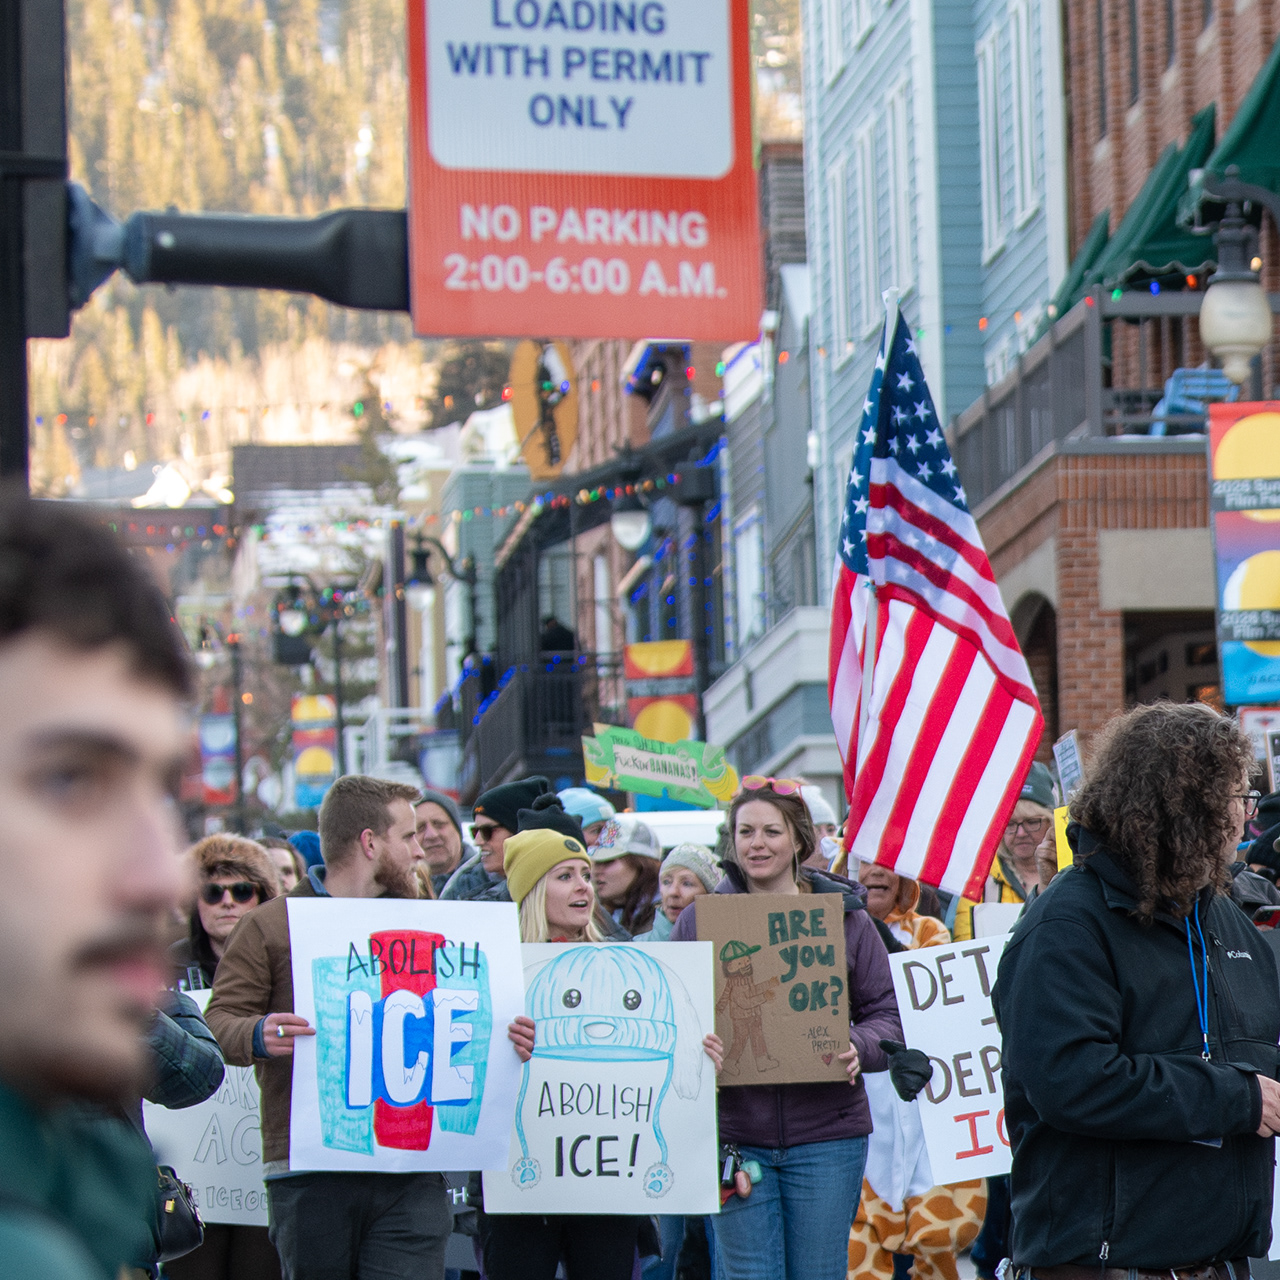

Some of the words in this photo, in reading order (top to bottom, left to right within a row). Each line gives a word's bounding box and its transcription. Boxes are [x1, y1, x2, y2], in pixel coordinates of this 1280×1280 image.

[491, 0, 666, 34] LOADING
[446, 42, 550, 78] WITH
[562, 47, 712, 84] PERMIT
[528, 93, 635, 130] ONLY
[460, 204, 521, 241] NO
[529, 206, 709, 248] PARKING
[443, 253, 631, 294] 2:00-6:00
[639, 260, 728, 299] A.M.
[767, 908, 828, 946] ARE
[346, 937, 481, 983] ABOLISH
[902, 945, 992, 1012] DET
[788, 975, 844, 1016] OK?
[345, 986, 480, 1111] ICE
[923, 1045, 1003, 1105] DEP
[539, 1080, 656, 1124] ABOLISH
[554, 1133, 640, 1179] ICE!
